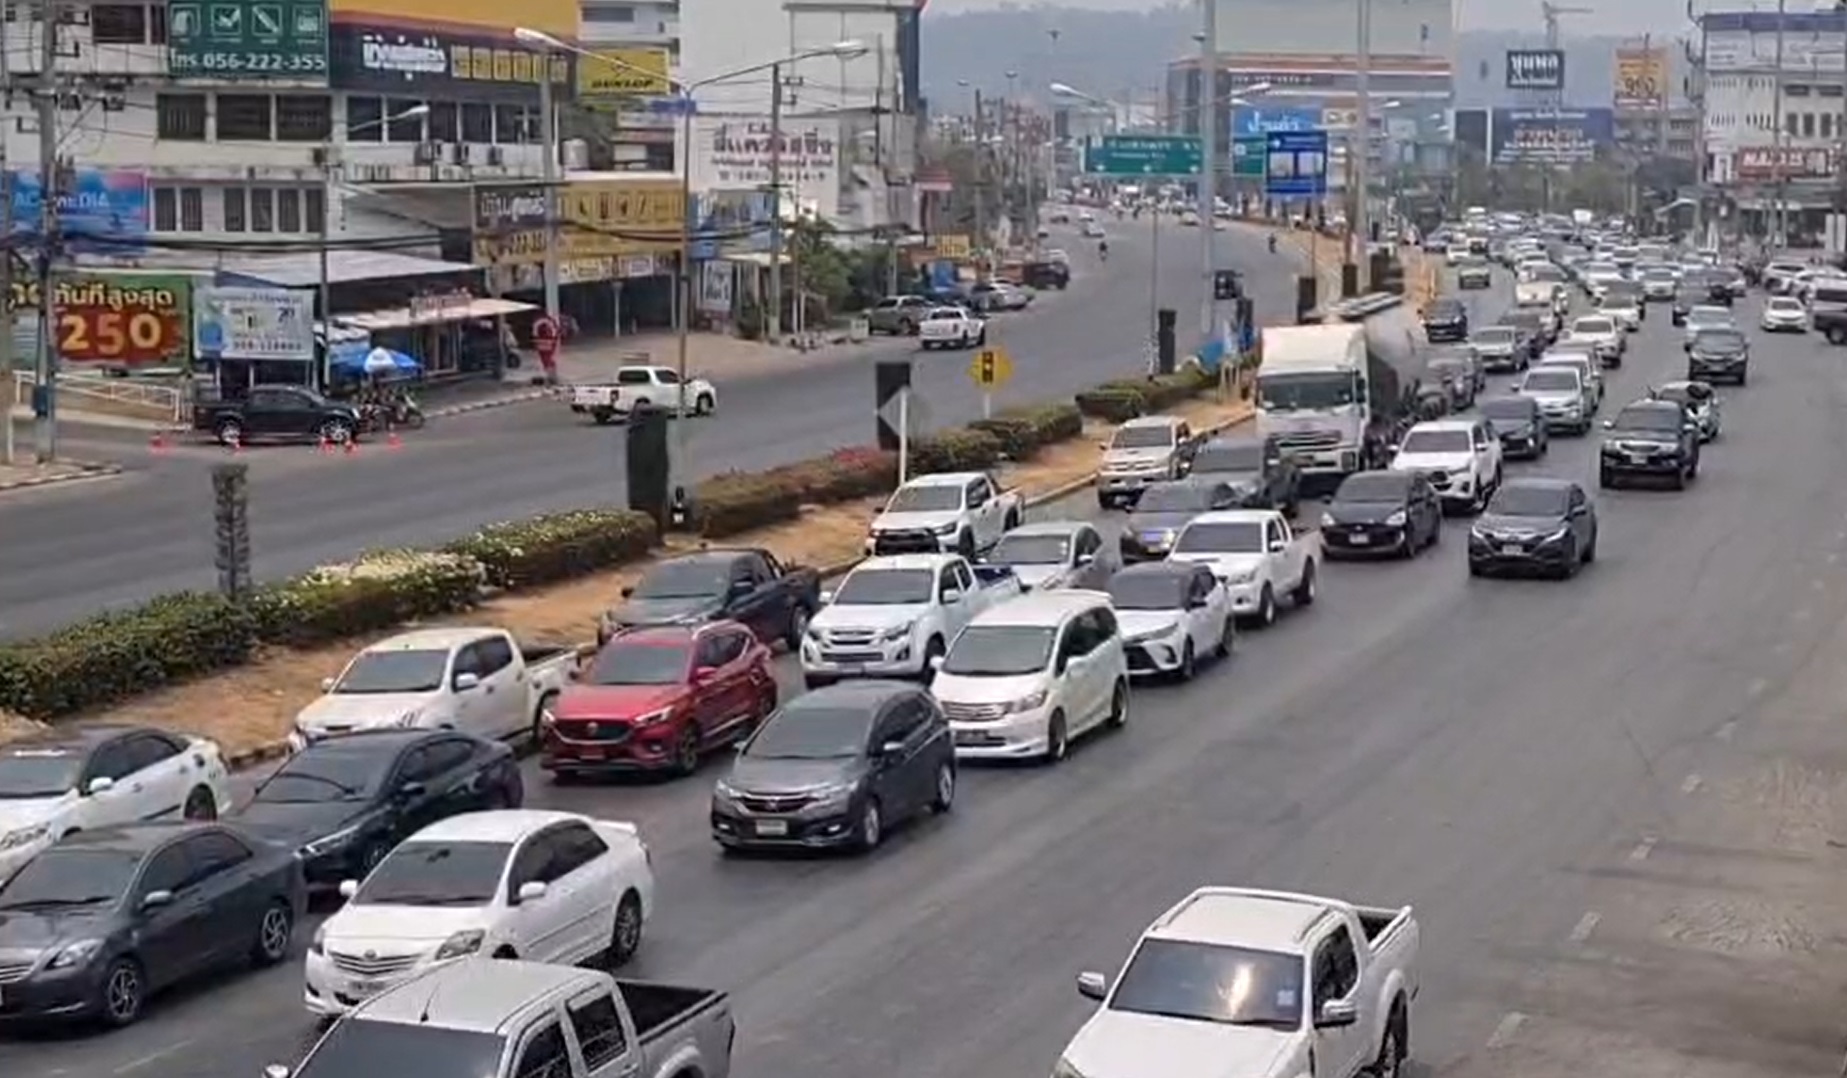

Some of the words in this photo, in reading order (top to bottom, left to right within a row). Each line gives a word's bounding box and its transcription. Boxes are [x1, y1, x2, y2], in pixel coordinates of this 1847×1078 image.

[203, 52, 326, 70] 056-222-355
[592, 79, 654, 88] DUNLOP
[61, 313, 162, 355] 250
